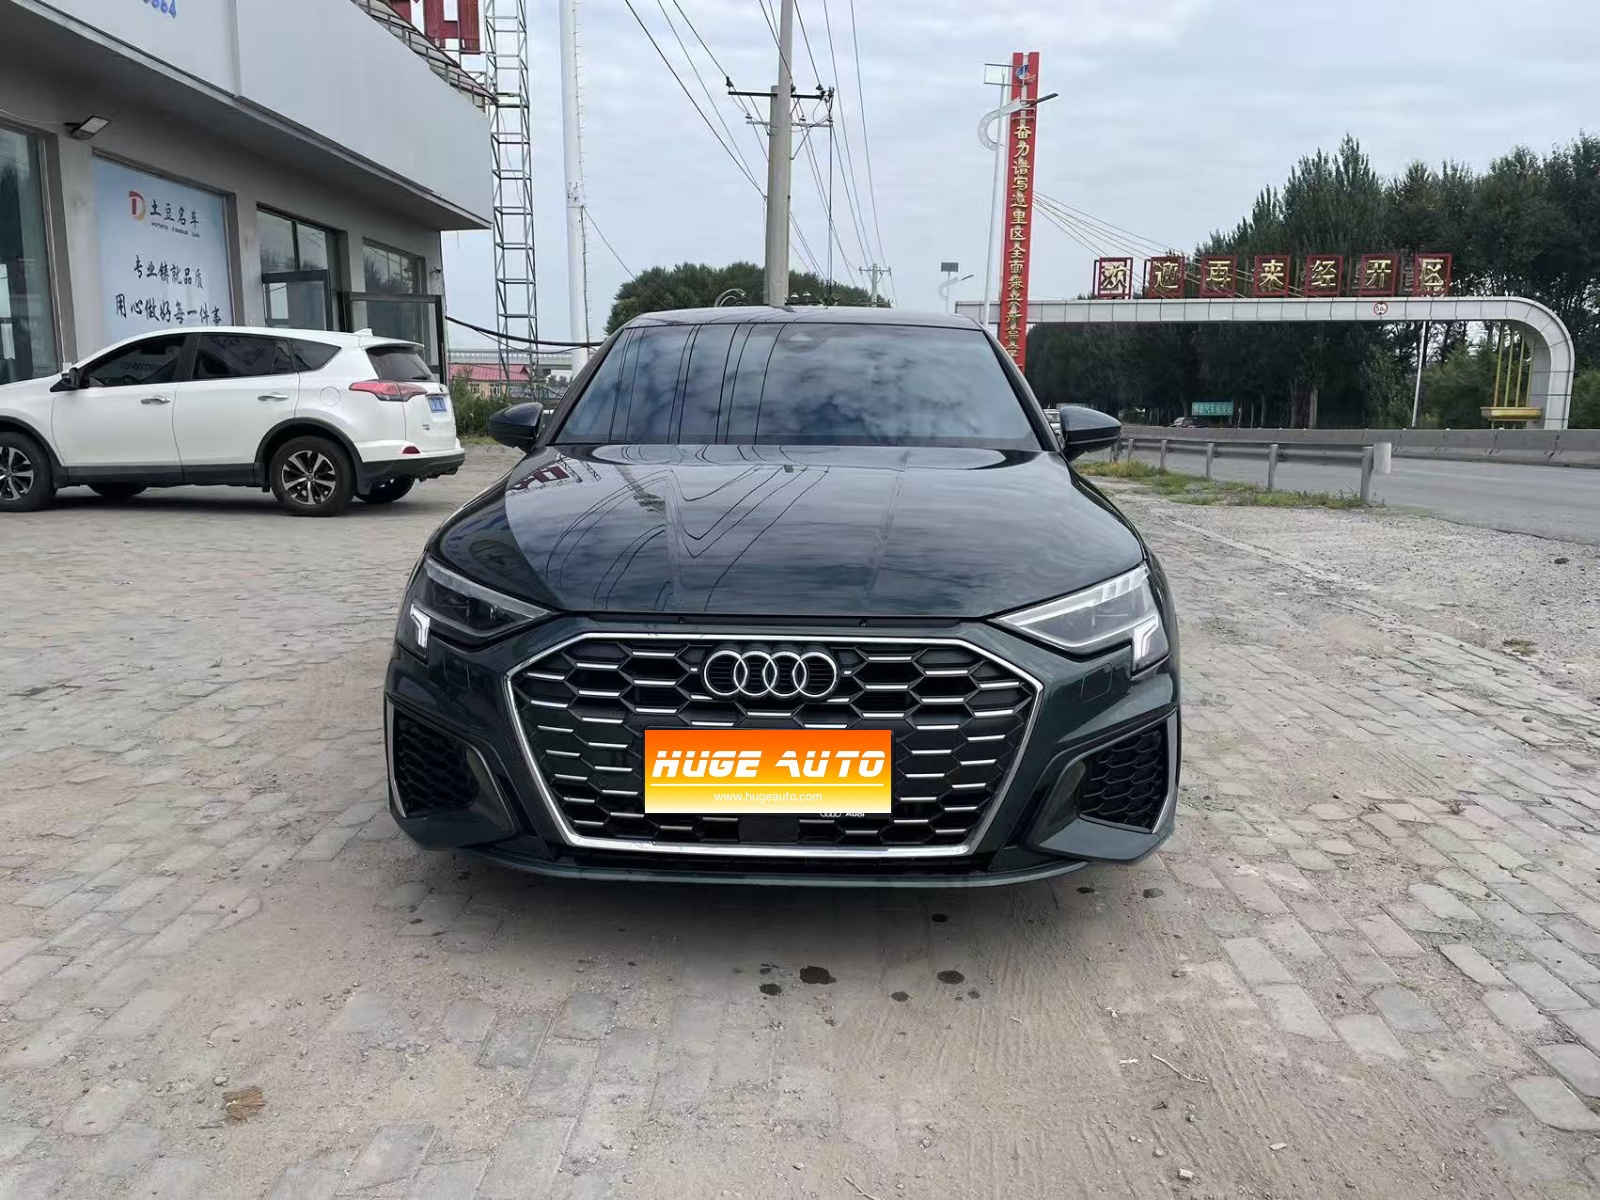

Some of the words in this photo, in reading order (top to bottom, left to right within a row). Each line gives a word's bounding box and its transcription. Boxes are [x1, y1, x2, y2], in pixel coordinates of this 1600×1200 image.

[150, 199, 199, 228] 土豆名车
[115, 293, 222, 326] 用心做好每一件事
